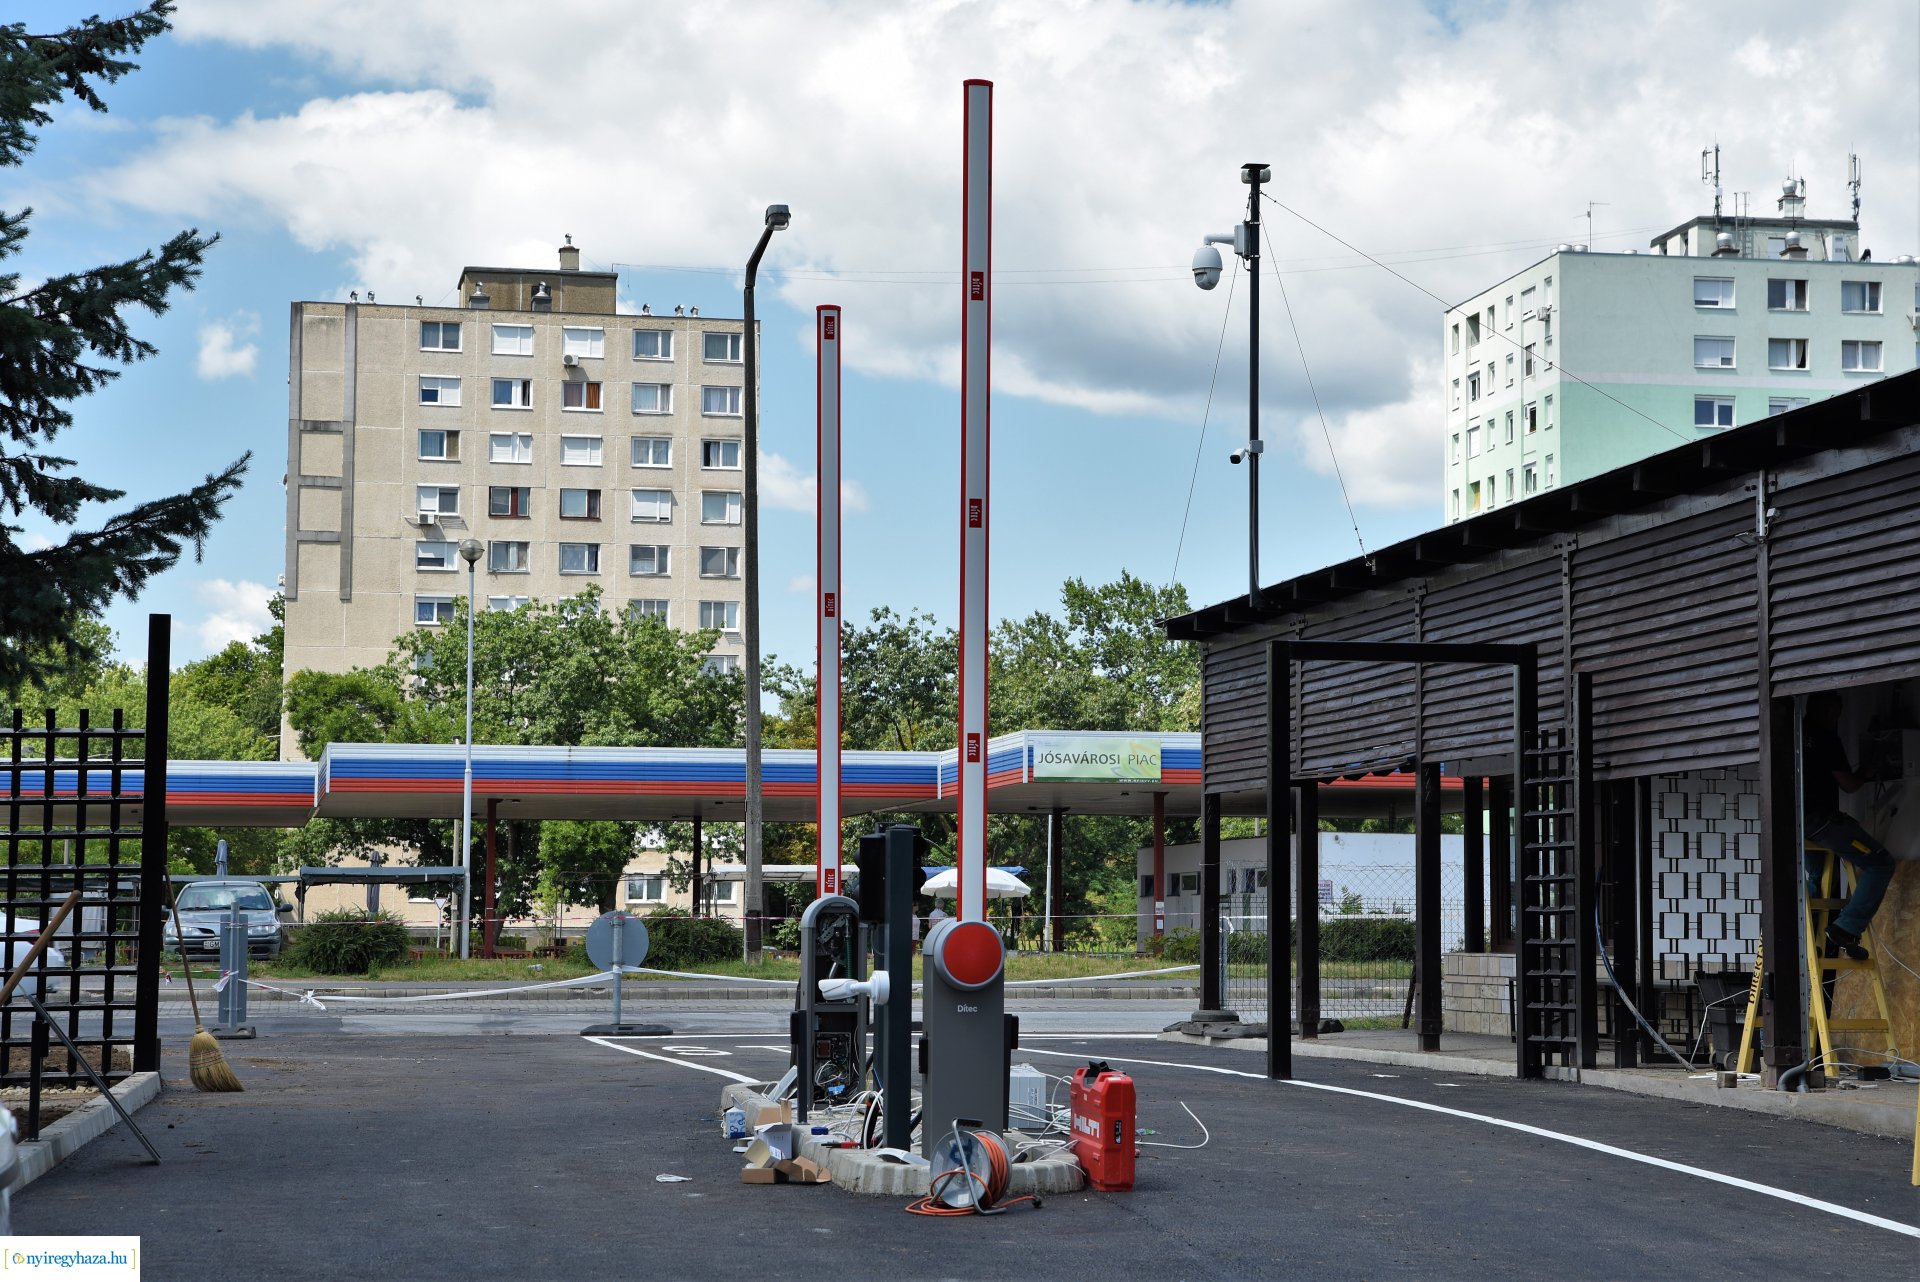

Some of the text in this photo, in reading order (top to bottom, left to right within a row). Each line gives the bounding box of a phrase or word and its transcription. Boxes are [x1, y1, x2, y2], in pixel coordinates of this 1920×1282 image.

[1038, 750, 1157, 766] JÓSAVÁROSI PIAC
[1749, 941, 1763, 1005] DIREKT
[1073, 1113, 1100, 1139] HILTI
